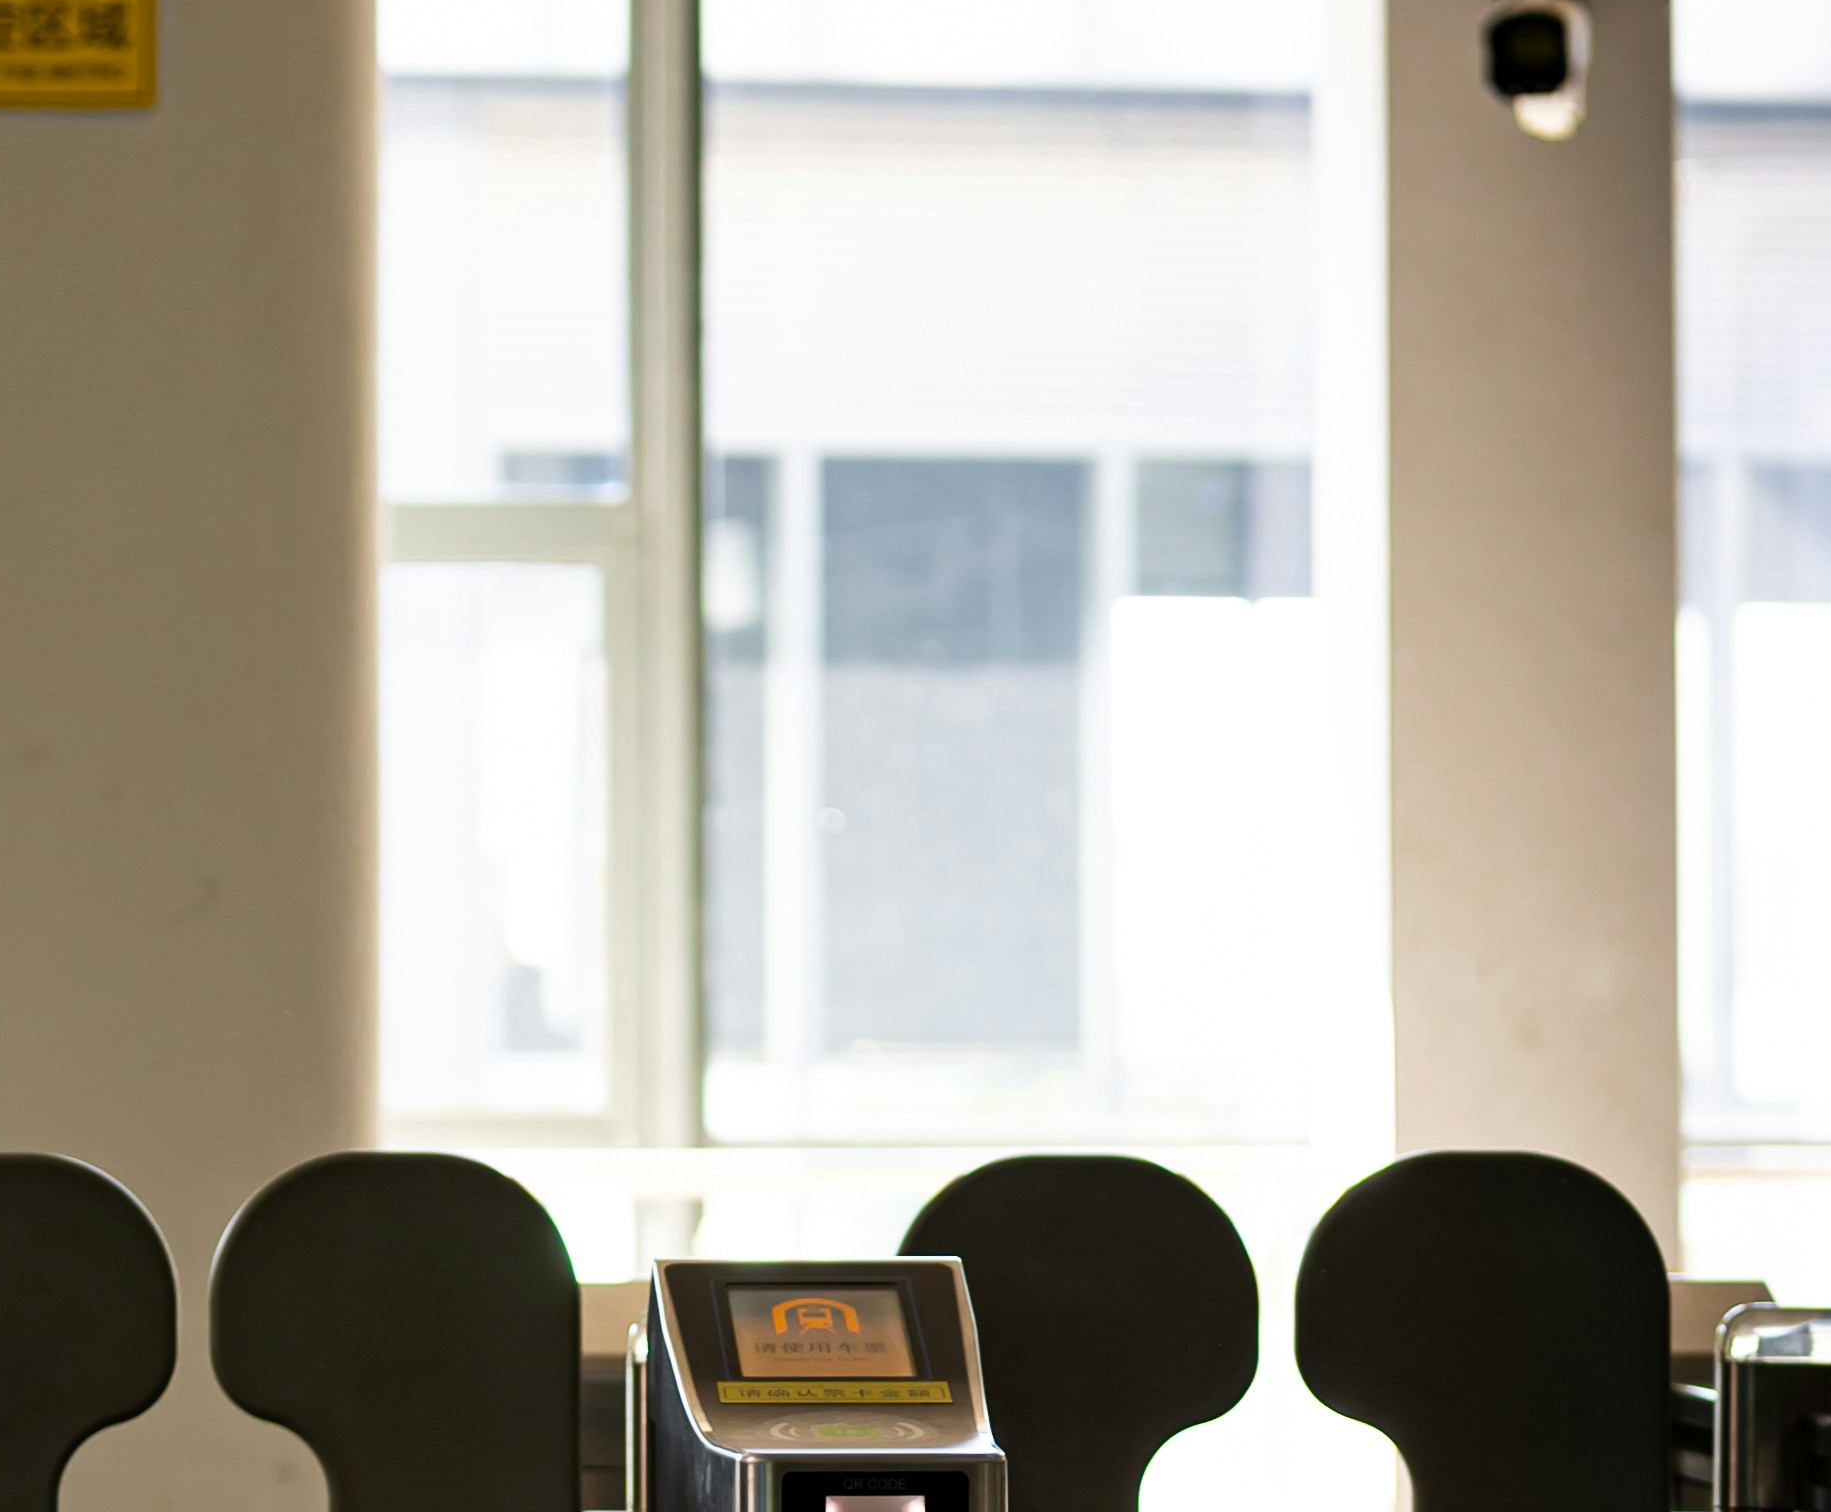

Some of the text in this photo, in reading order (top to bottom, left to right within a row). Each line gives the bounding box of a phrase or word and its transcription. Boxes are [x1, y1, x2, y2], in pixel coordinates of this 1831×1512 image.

[754, 1341, 888, 1354] 请使用车票
[739, 1387, 931, 1398] 请确认票卡金额
[842, 1478, 908, 1490] QR CODE
